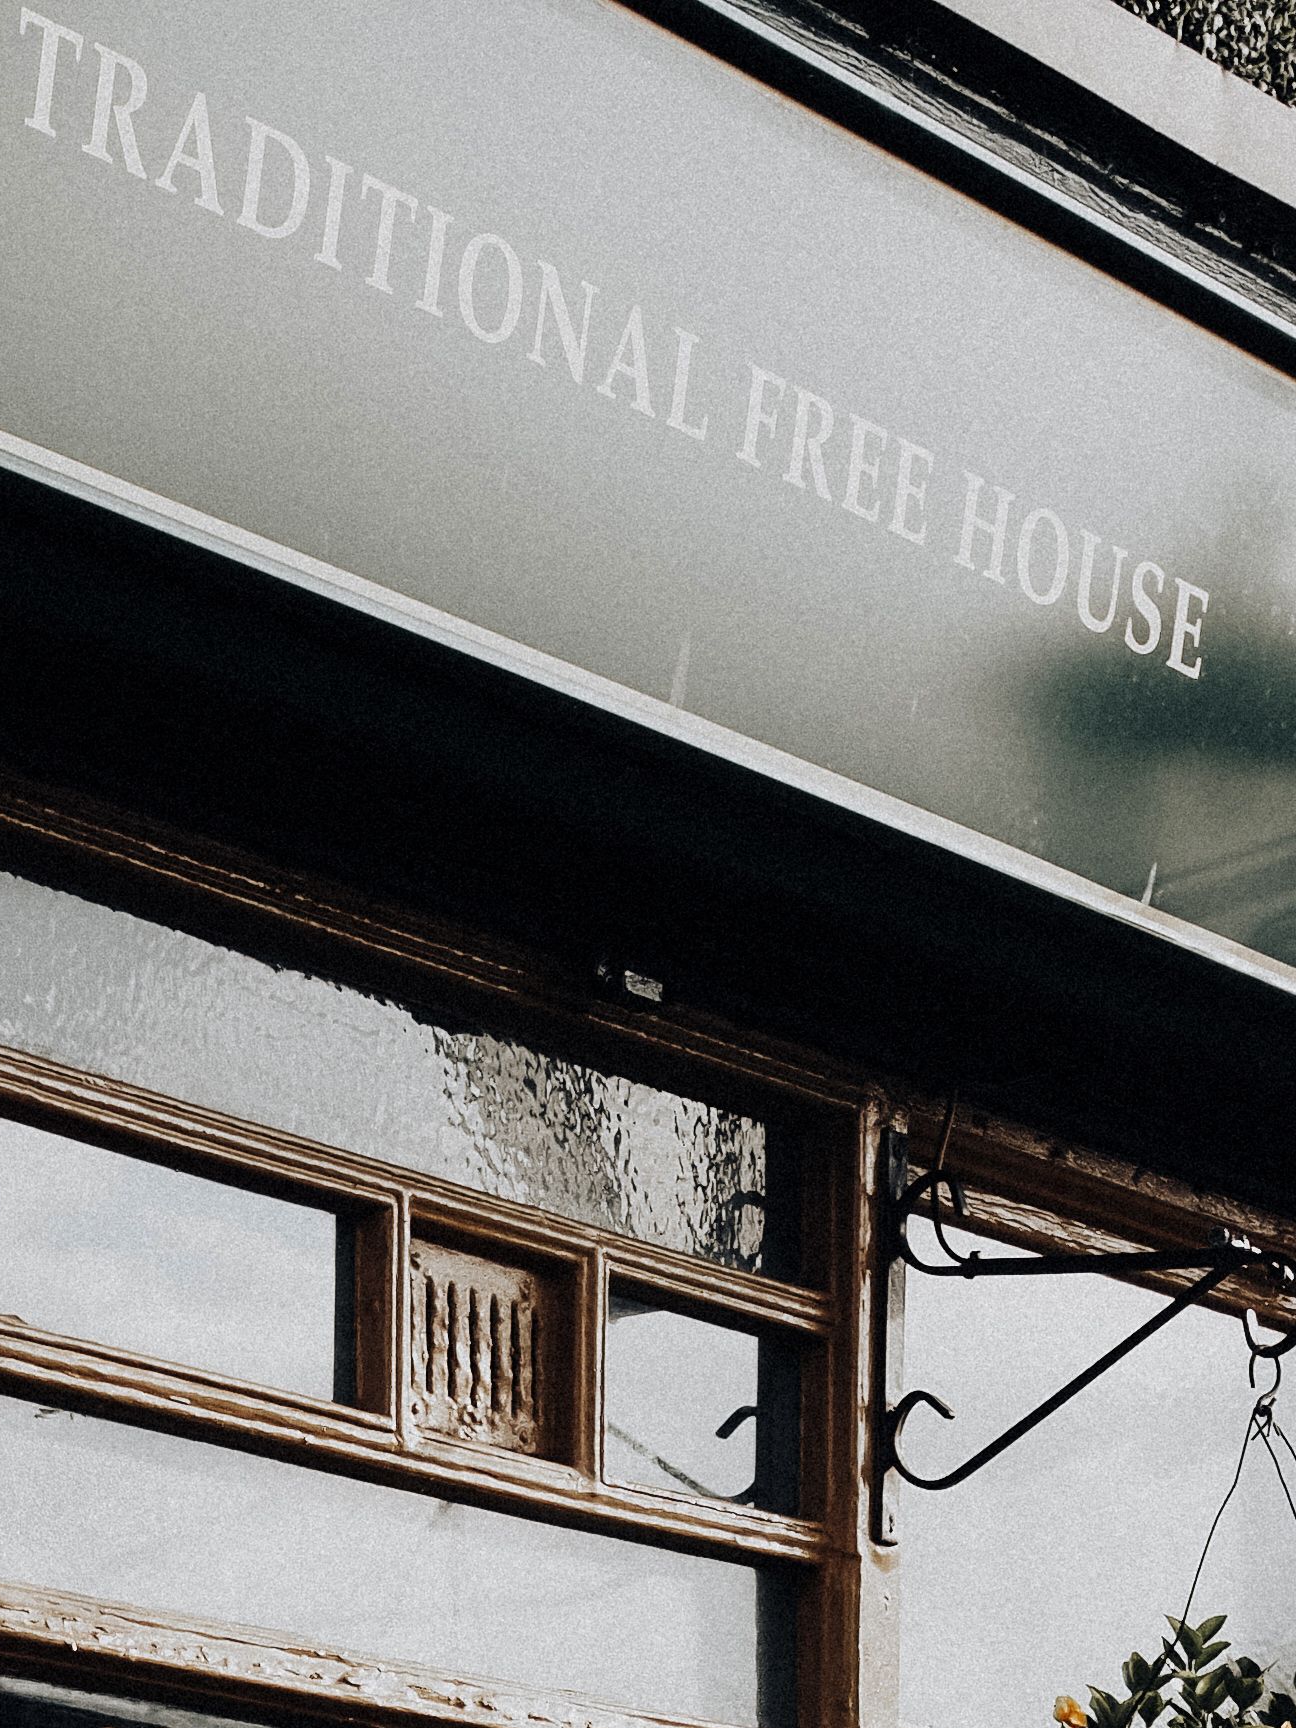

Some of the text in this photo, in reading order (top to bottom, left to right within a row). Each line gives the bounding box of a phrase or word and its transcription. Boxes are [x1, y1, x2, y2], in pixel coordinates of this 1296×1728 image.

[19, 6, 1210, 679] TRADITIONAL FREE HOUSE
